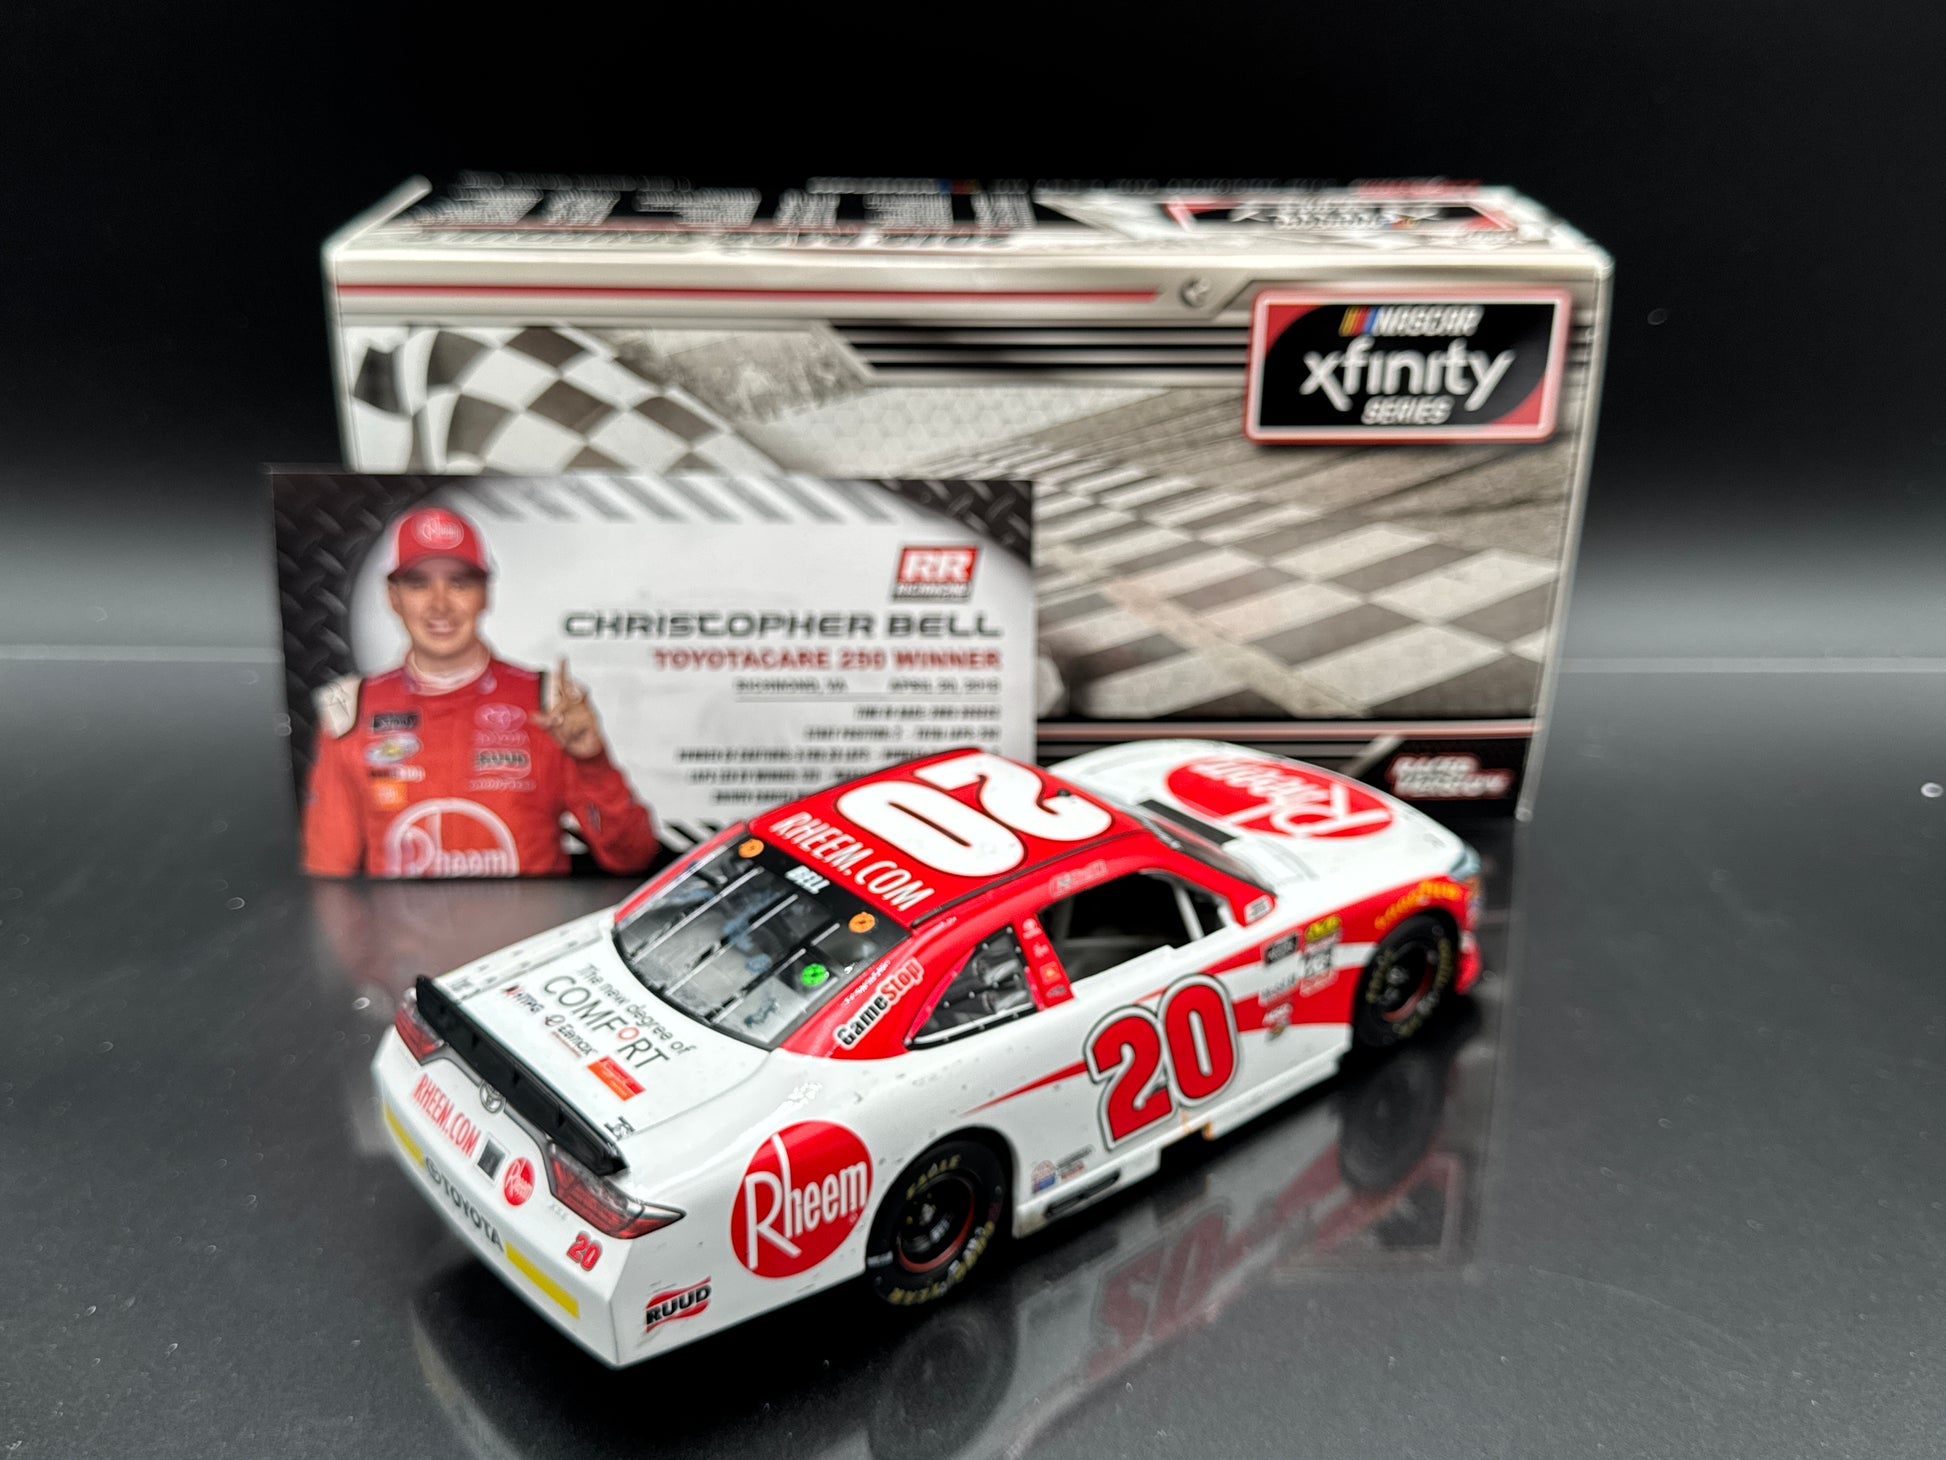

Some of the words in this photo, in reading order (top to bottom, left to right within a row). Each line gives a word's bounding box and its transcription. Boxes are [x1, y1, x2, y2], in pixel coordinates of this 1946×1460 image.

[1372, 304, 1485, 337] NASCAR
[1300, 335, 1517, 412] xfinity
[1361, 395, 1455, 425] SERIES
[564, 612, 875, 637] CHRISTOPHER
[888, 612, 1003, 637] BELL
[654, 649, 831, 670] TOYOTACARE
[895, 649, 1002, 670] WINNER
[837, 752, 1113, 877] 20
[769, 812, 936, 911] RHEEM.COM
[544, 975, 671, 1068] COMFORT
[626, 1003, 674, 1041] degree
[670, 1040, 698, 1055] of
[836, 960, 922, 1046] GameStop
[1086, 977, 1238, 1147] 20
[413, 1073, 482, 1158] RHEEM.COM
[440, 1172, 505, 1253] TOYOTA
[745, 1133, 868, 1272] Rheem
[566, 1231, 603, 1272] 20
[645, 1284, 712, 1326] RUUD
